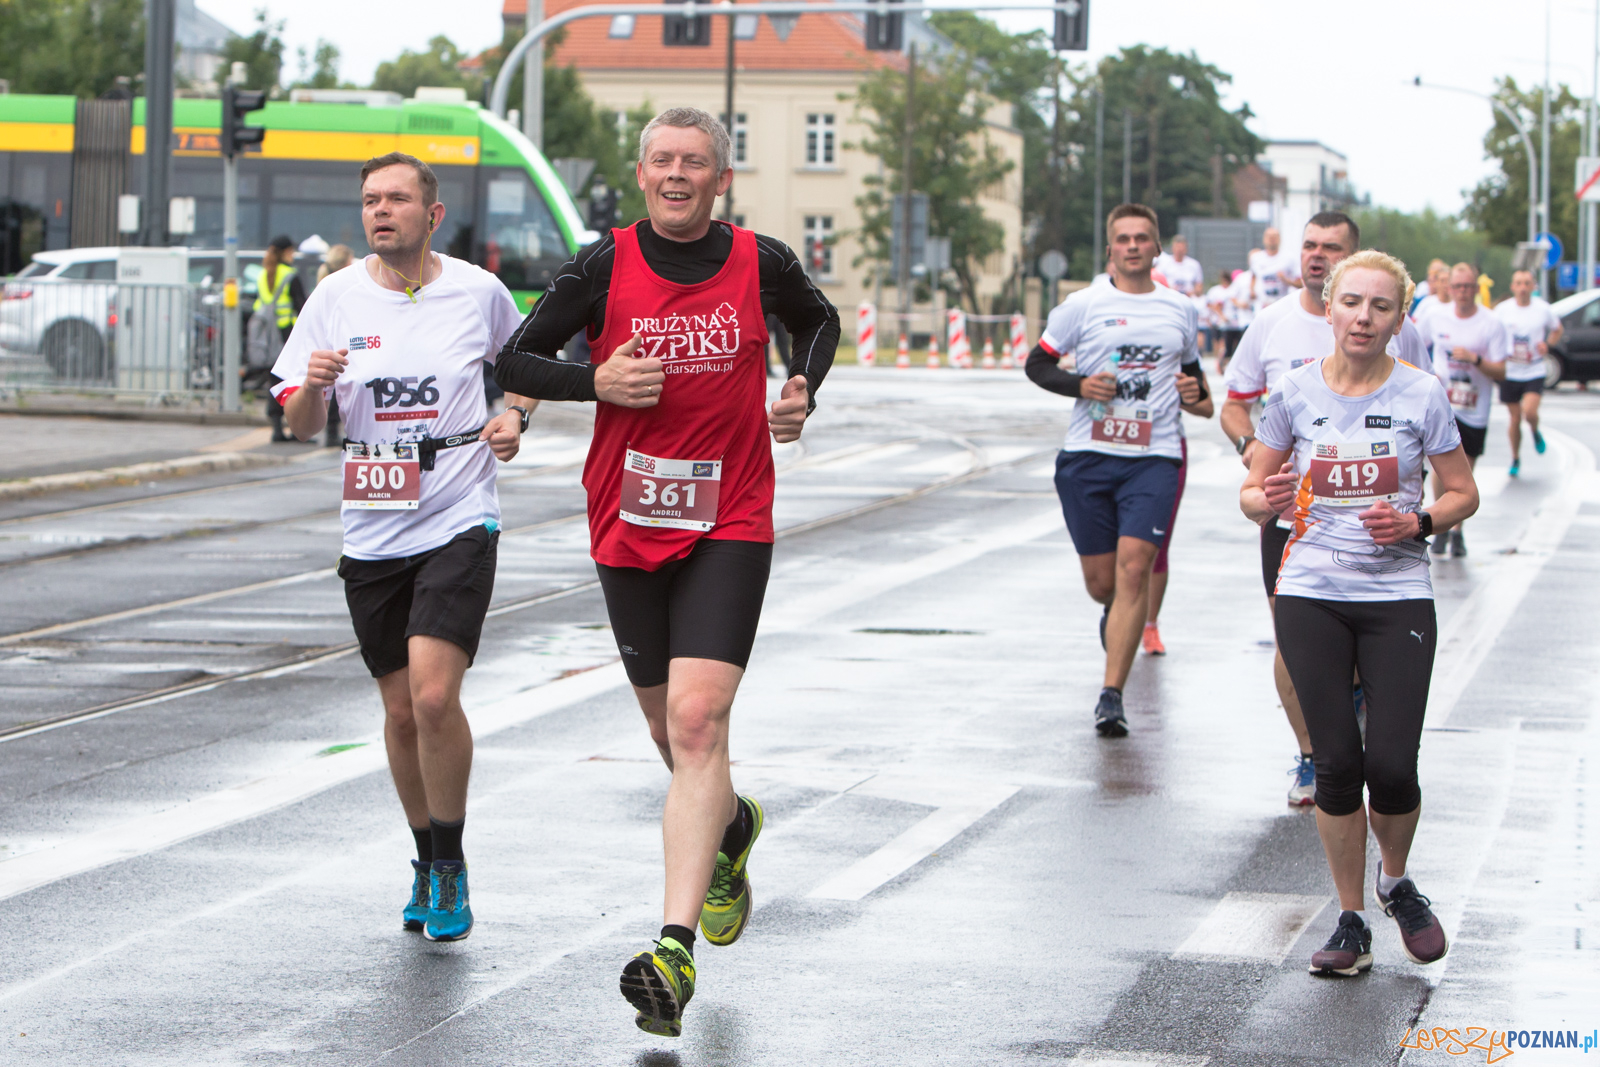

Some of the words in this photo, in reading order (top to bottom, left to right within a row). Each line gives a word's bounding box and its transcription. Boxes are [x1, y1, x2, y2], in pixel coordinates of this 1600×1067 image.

[631, 312, 722, 333] DRUŻYNA
[665, 361, 733, 374] darszpiku.pl
[365, 375, 440, 408] 1956
[1103, 419, 1139, 439] 878
[355, 465, 405, 490] 500
[1327, 462, 1379, 487] 419
[638, 479, 696, 508] 361
[1334, 488, 1374, 496] DOBROCHNA
[650, 509, 682, 518] ANDRZEJ
